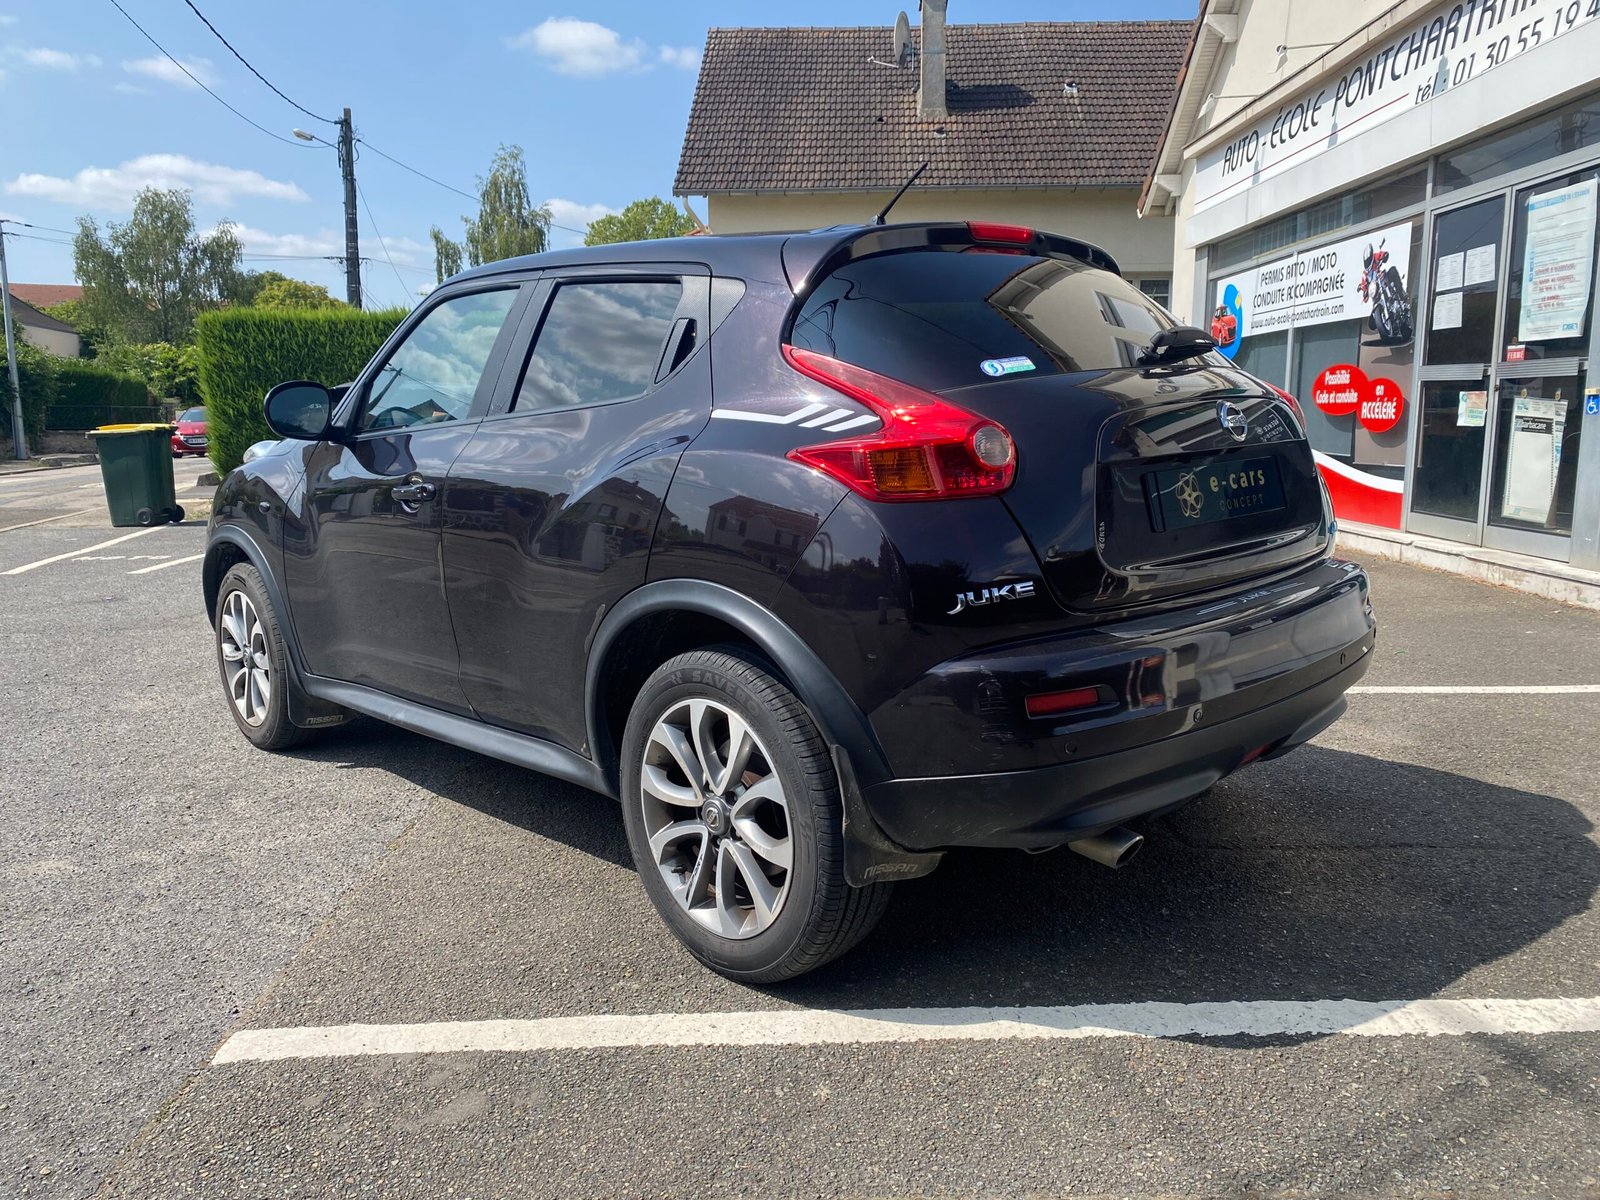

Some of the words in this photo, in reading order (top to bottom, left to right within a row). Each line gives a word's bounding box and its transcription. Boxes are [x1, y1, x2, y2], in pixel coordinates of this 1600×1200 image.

[1453, 51, 1477, 87] 01
[1482, 34, 1511, 72] 30
[1515, 16, 1545, 53] 55
[1553, 0, 1582, 37] 19
[1222, 129, 1260, 177] AUTO
[1270, 90, 1326, 150] ÉCOLE
[1331, 0, 1537, 118] PONTCHARTR
[1260, 266, 1285, 287] PERMIS
[1311, 251, 1337, 274] MOTO
[1252, 286, 1285, 309] CONDUITE
[1286, 270, 1345, 301] ACCOMPAGNÉE
[1324, 369, 1350, 386] Possibilité
[1316, 389, 1329, 404] Code
[1329, 391, 1336, 403] et
[1335, 388, 1358, 404] conduite
[1375, 385, 1384, 396] en
[1361, 397, 1397, 420] ACCÉLÉRÉ
[1209, 469, 1265, 493] e-cars
[1219, 493, 1264, 511] CONCEPT
[947, 580, 1036, 615] JUKE
